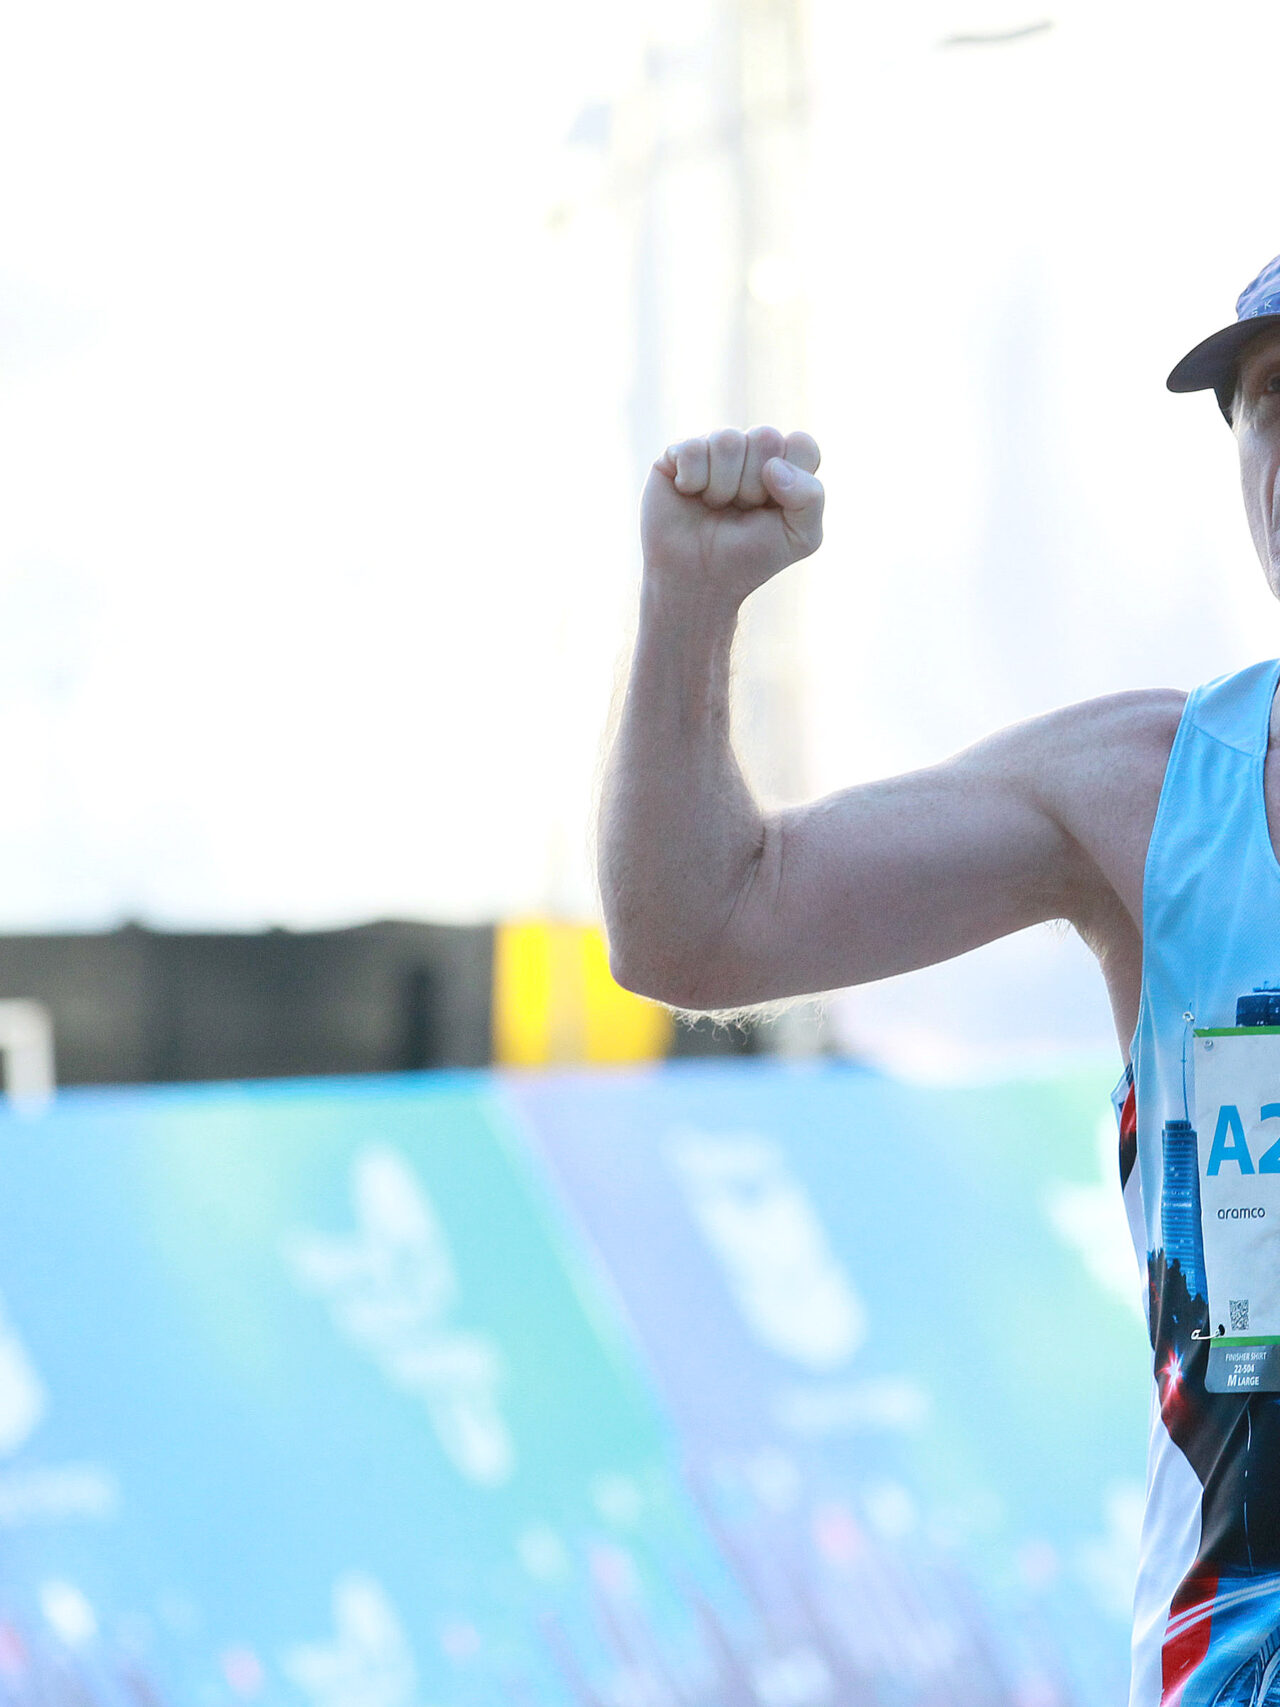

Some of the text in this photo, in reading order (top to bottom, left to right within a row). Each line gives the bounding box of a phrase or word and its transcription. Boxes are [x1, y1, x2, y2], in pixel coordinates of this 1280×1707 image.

[1217, 1206, 1266, 1220] aramco
[1225, 1351, 1267, 1362] FINISHER SHIRT
[1234, 1364, 1255, 1374] 22-504
[1227, 1374, 1260, 1387] M LARGE
